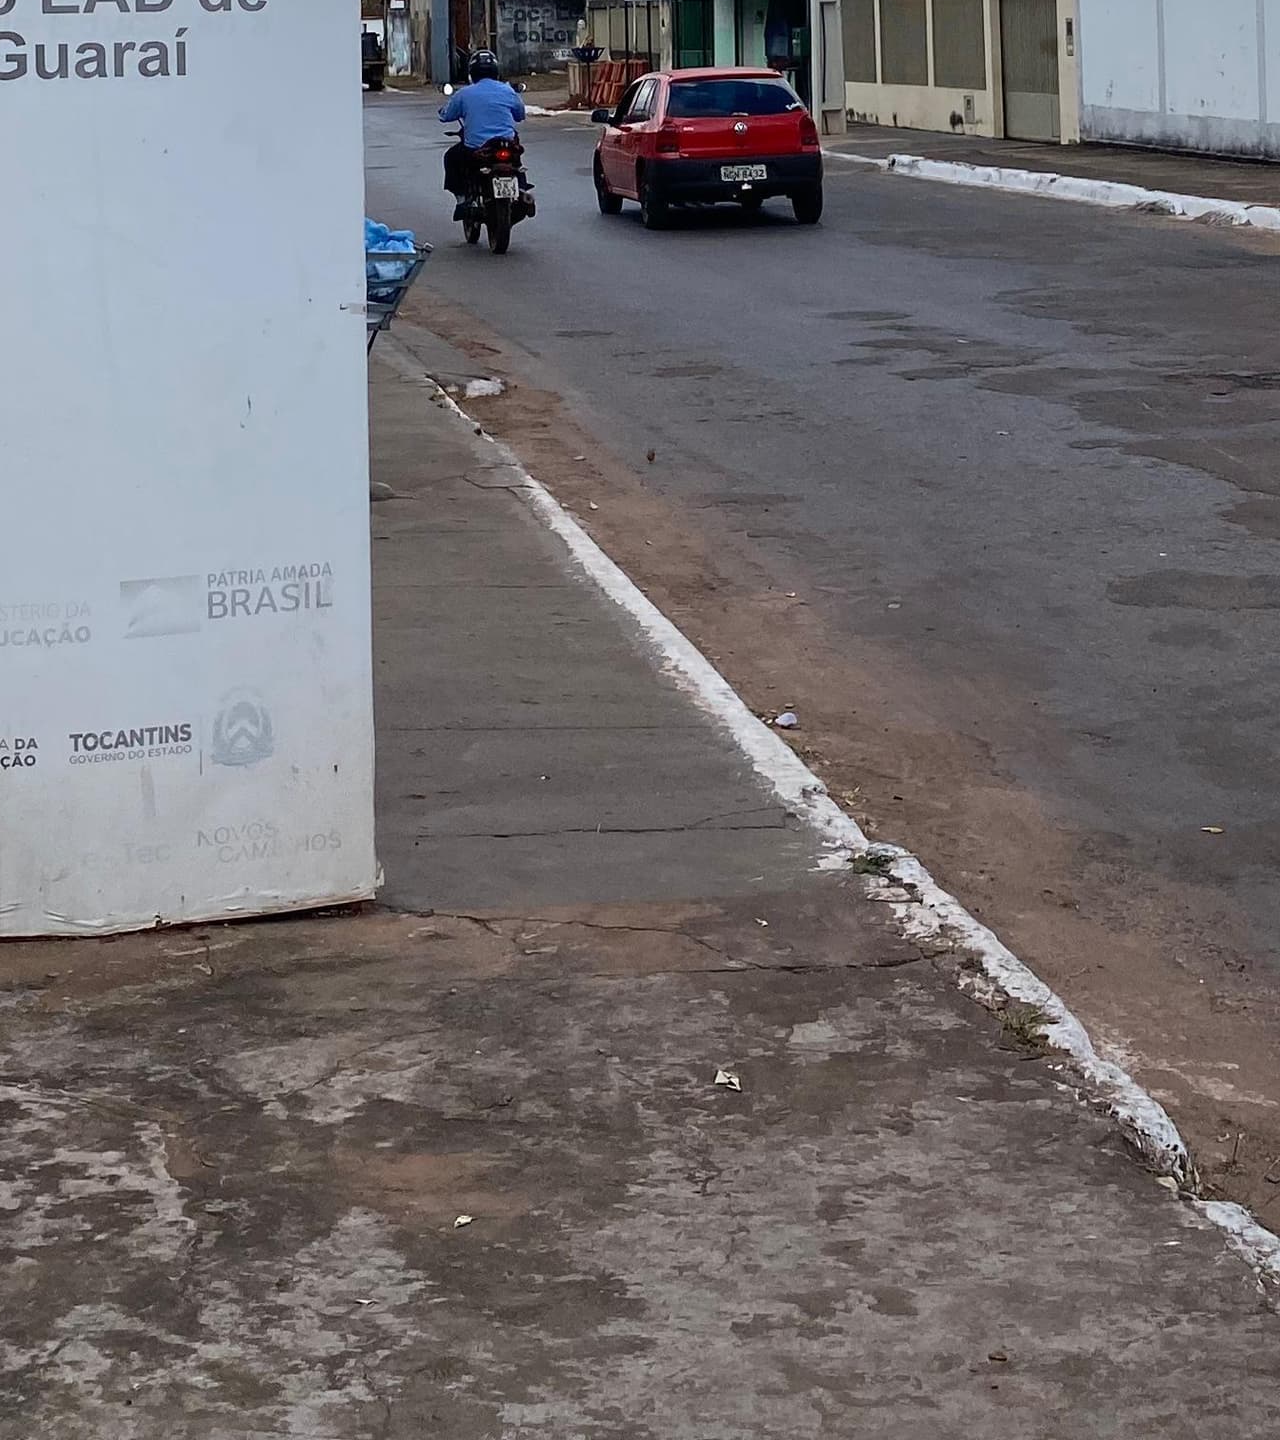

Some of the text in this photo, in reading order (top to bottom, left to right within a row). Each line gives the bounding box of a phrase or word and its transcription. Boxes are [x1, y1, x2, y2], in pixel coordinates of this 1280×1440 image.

[271, 562, 333, 582] AMADA
[207, 580, 333, 619] BRASIL
[15, 737, 39, 752] DA
[69, 724, 192, 753] TOCANTINS
[69, 744, 193, 765] GOVERNO DO ESTADO
